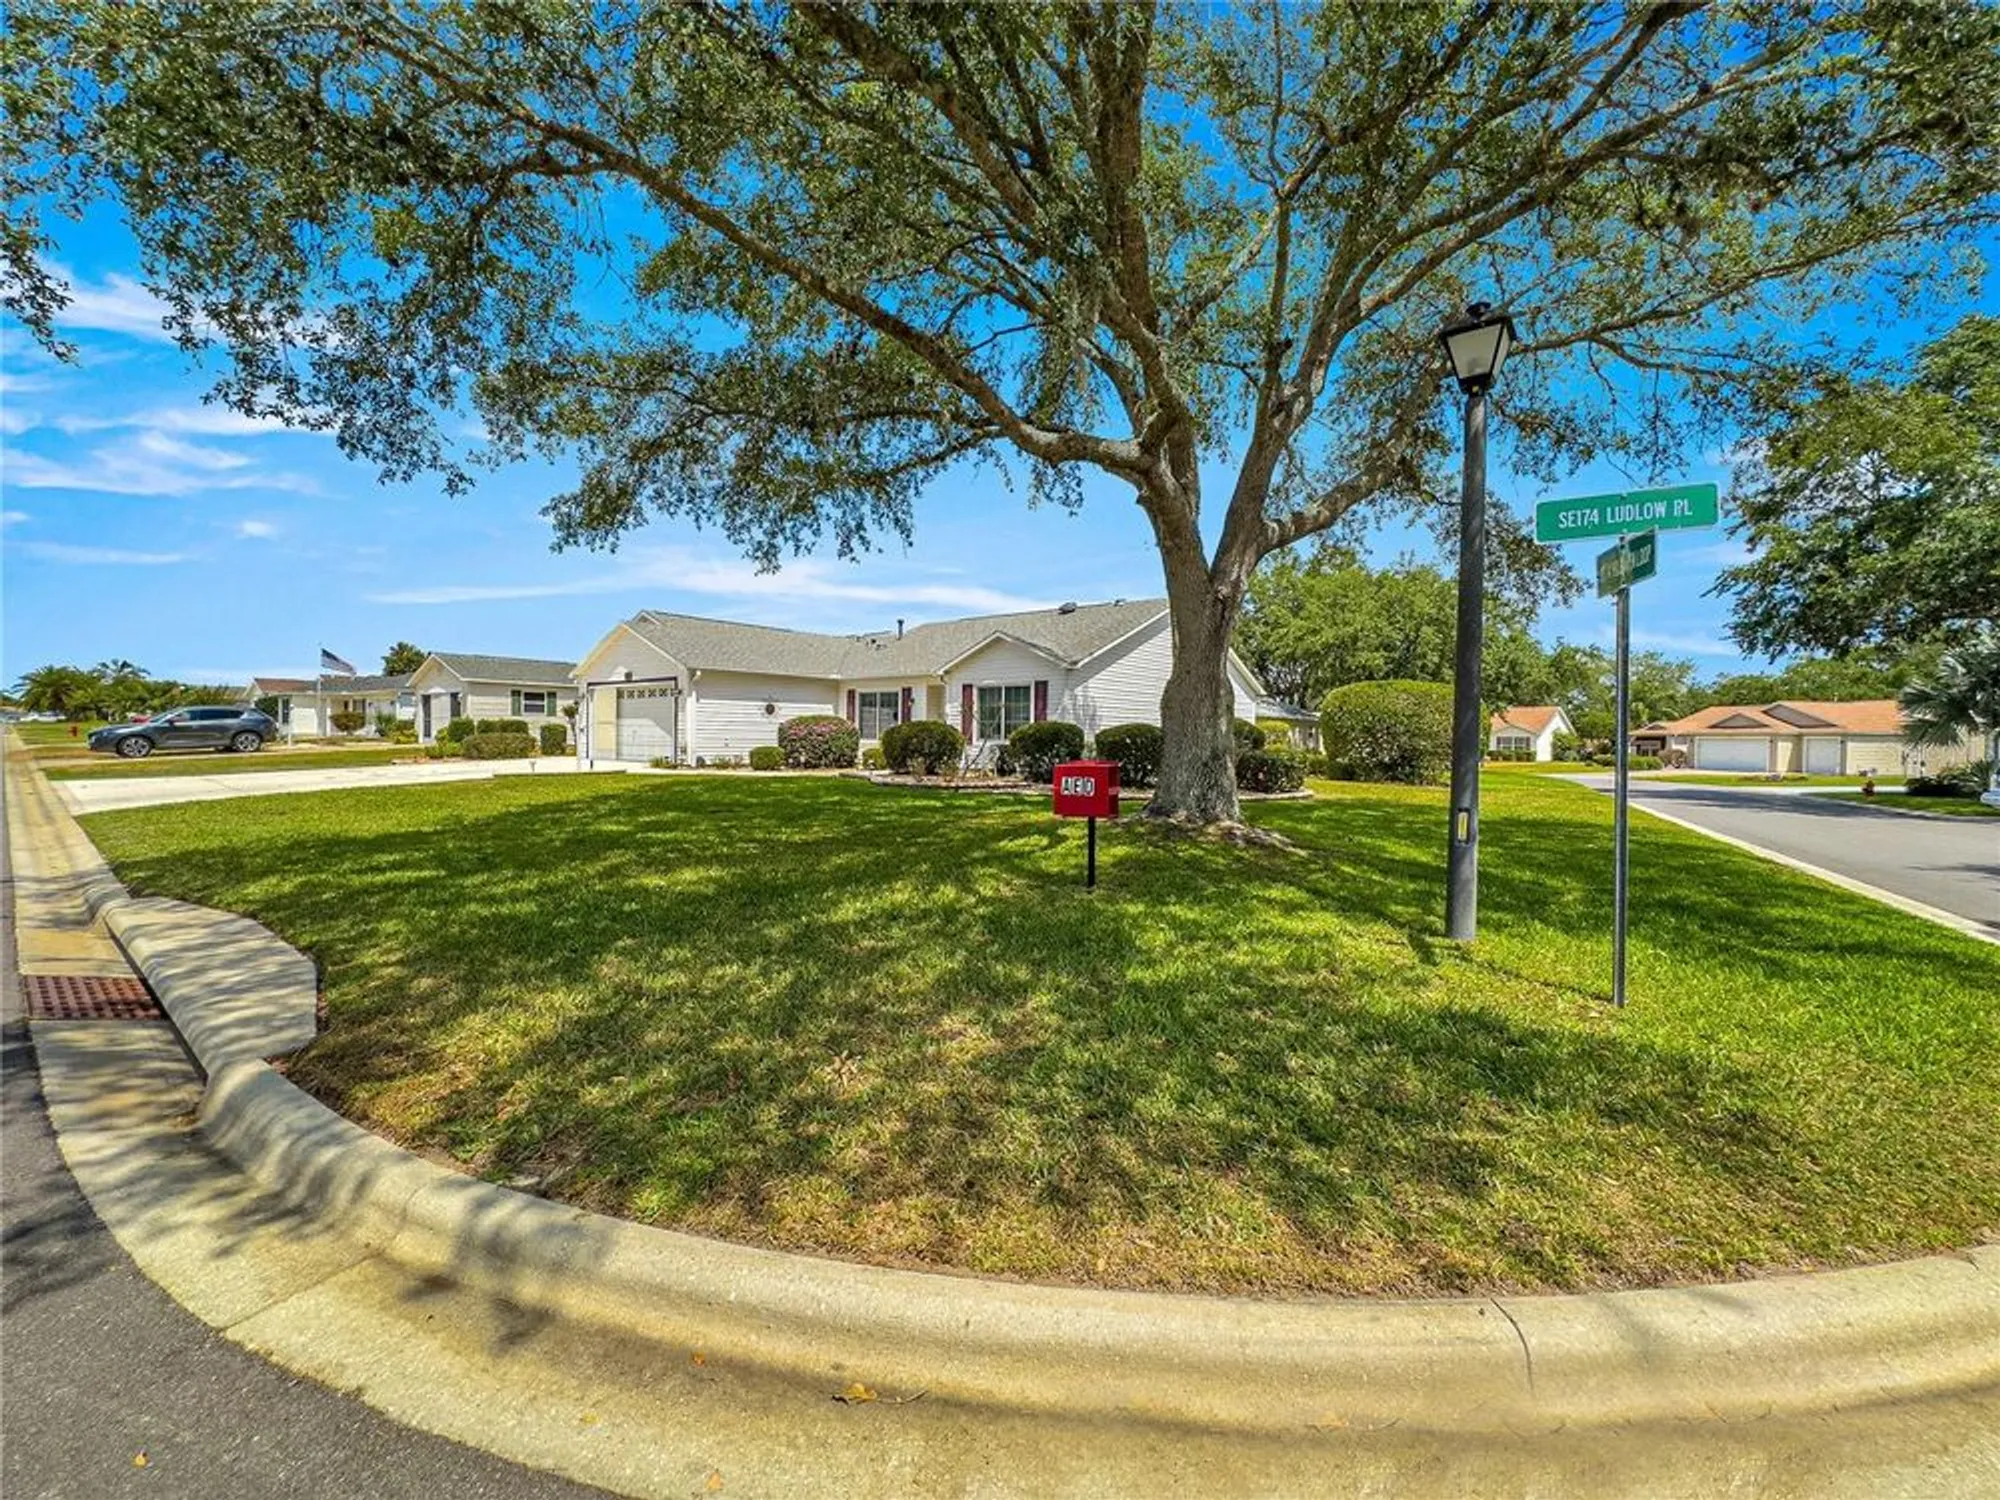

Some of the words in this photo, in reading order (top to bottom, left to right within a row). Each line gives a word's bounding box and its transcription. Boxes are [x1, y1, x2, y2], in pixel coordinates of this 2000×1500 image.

[1558, 510, 1599, 528] SE174
[1606, 501, 1667, 523] LUDLOW
[1674, 499, 1693, 517] PL
[1061, 777, 1094, 796] AED
